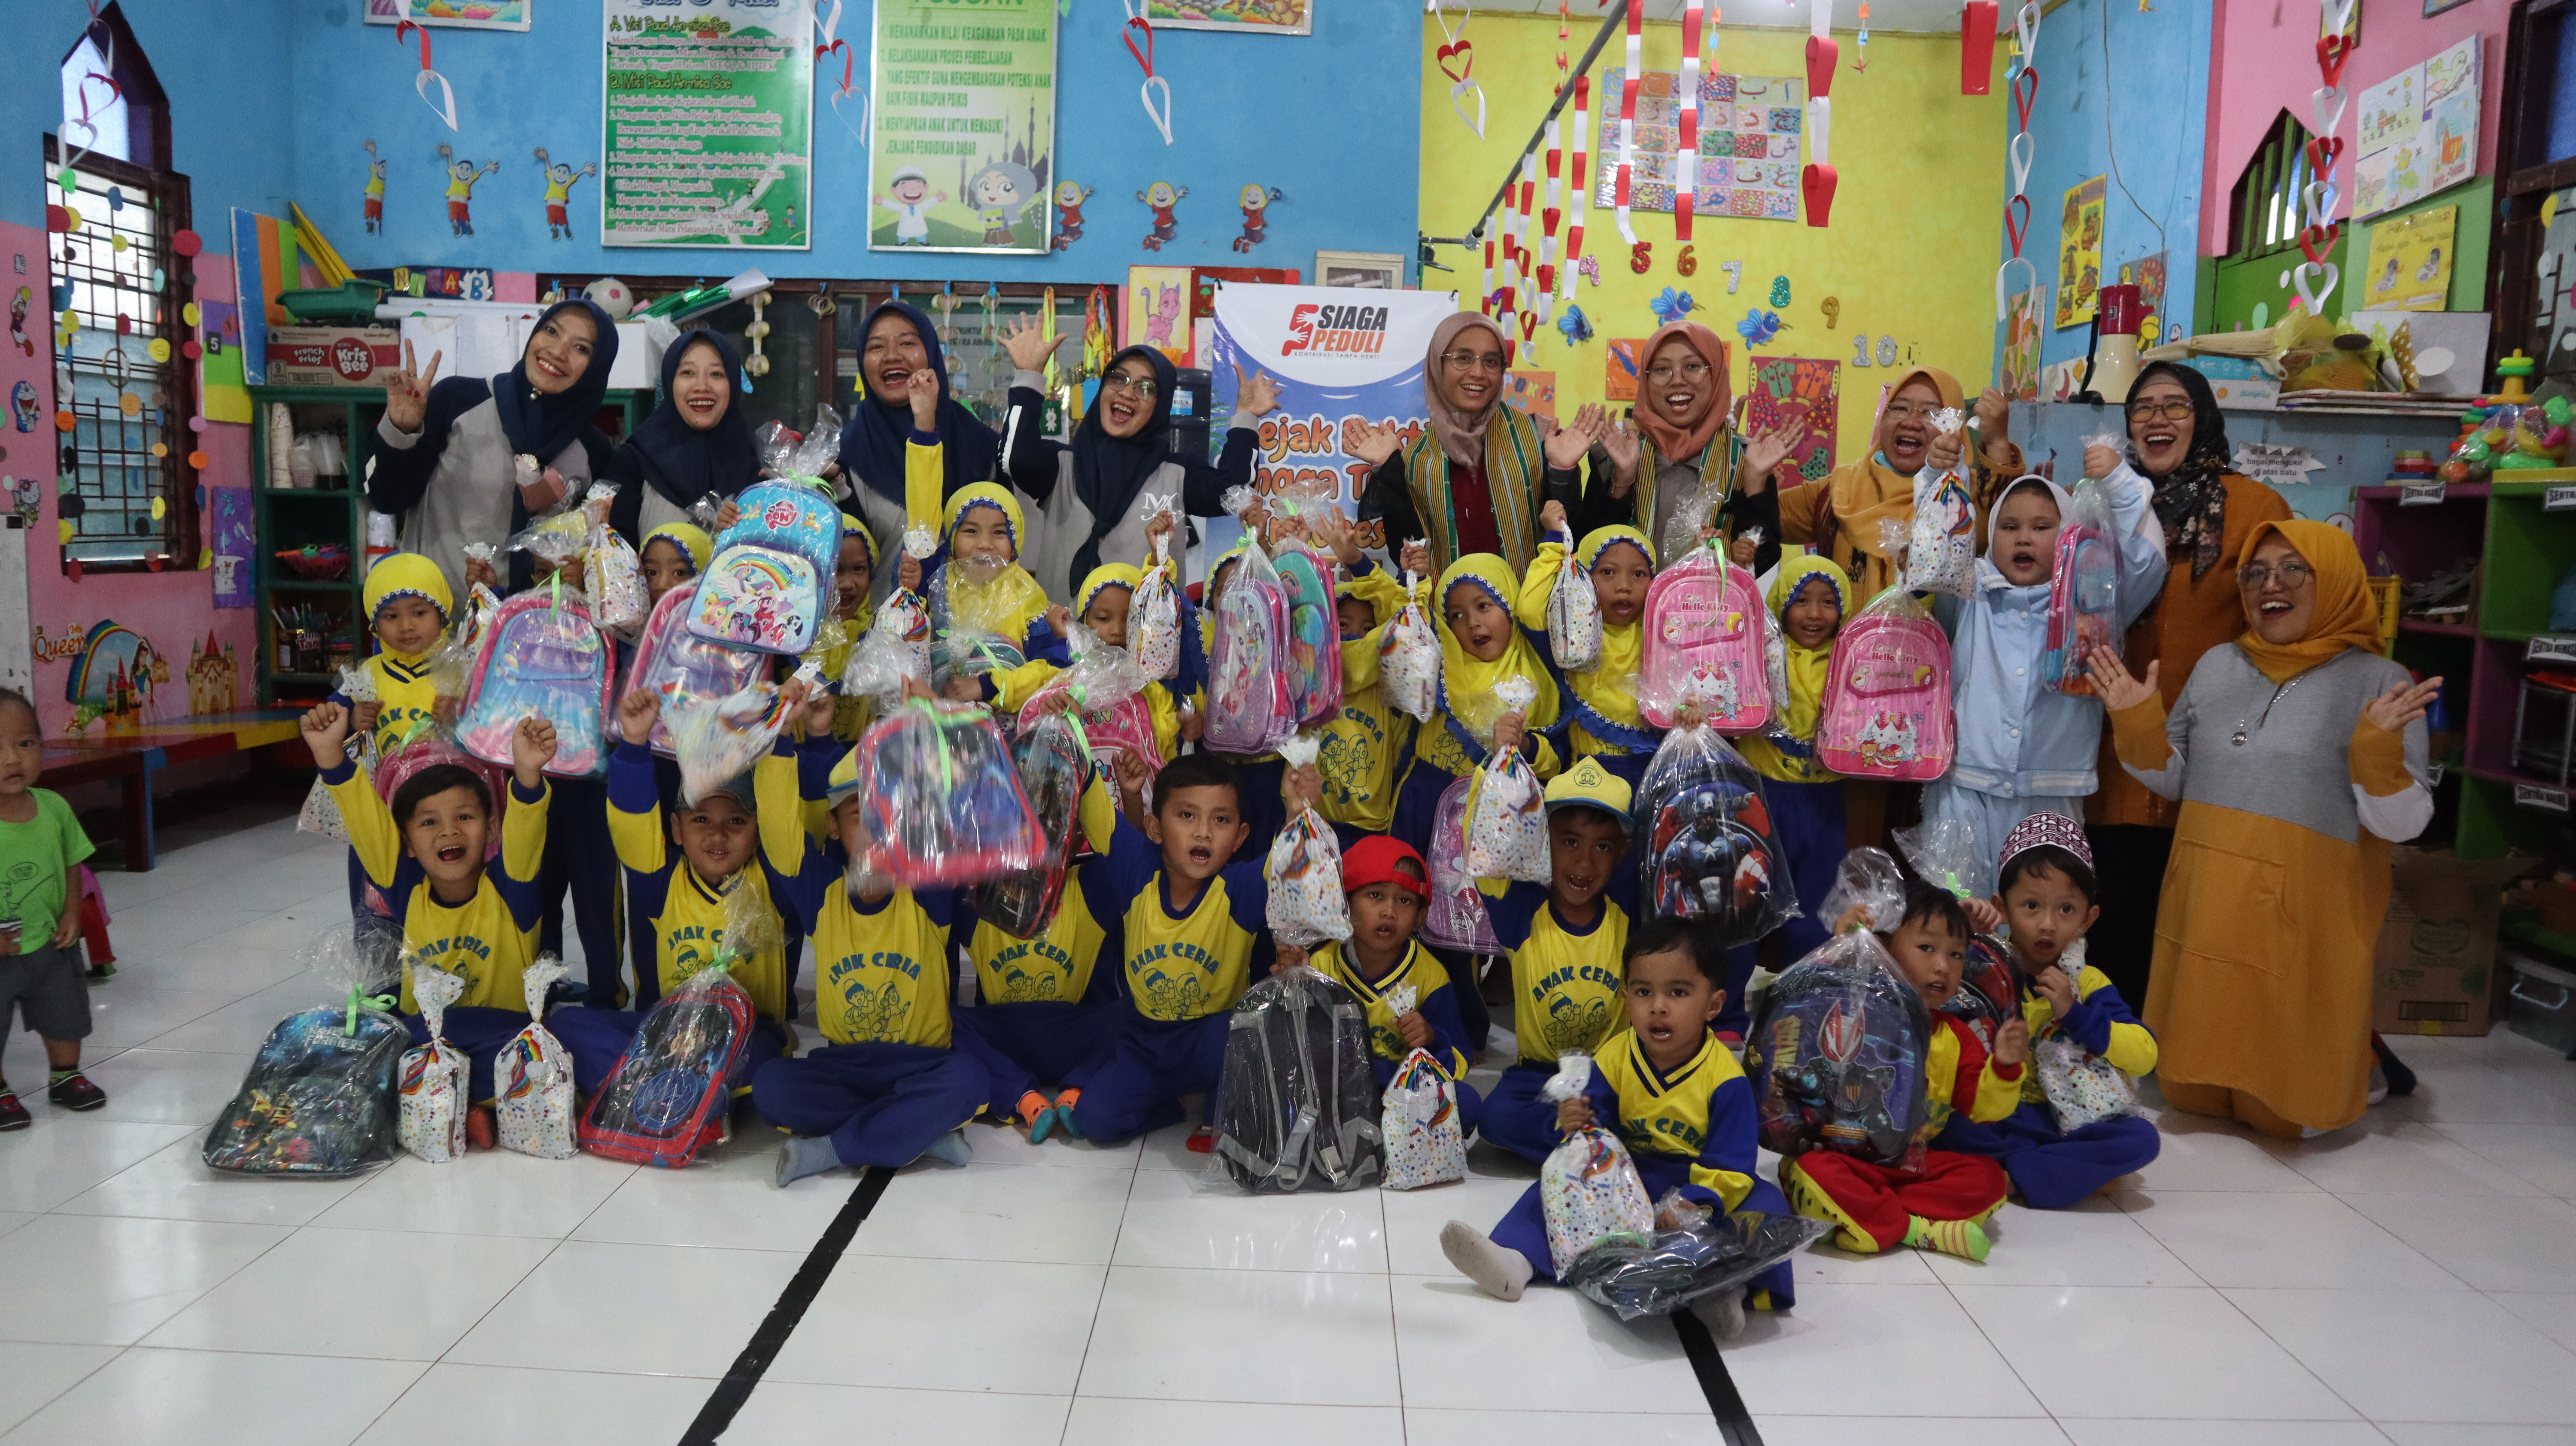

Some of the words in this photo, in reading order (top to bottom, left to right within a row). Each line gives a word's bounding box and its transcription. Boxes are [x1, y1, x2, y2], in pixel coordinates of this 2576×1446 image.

[624, 15, 642, 32] Visi
[645, 15, 670, 31] Paud
[1008, 27, 1025, 42] PADA
[1027, 28, 1047, 43] ANAK
[940, 50, 963, 64] PROSES
[622, 72, 644, 89] Misi
[646, 72, 671, 89] Paud
[887, 70, 903, 84] YANG
[1034, 73, 1051, 88] ANAK
[928, 118, 945, 132] ANAK
[947, 118, 968, 132] UNTUK
[886, 140, 914, 154] JENJANG
[956, 140, 977, 155] DASAR
[1579, 254, 1601, 286] 4
[1631, 242, 1652, 274] 5
[1677, 245, 1697, 276] 6
[1721, 260, 1742, 294] 7
[1769, 275, 1791, 308] 8
[1318, 304, 1388, 331] SIAGA
[1821, 296, 1840, 329] 9
[210, 337, 219, 351] 5
[294, 347, 325, 357] French
[1310, 329, 1385, 353] PEDULI
[1852, 334, 1897, 367] 10
[298, 354, 322, 365] Fries
[336, 346, 368, 362] Kris
[339, 360, 369, 375] Bee
[1258, 416, 1333, 463] ejak
[2247, 458, 2267, 466] bagai
[2269, 459, 2303, 467] mengukir
[1255, 467, 1338, 505] ngga
[1681, 602, 1705, 611] Hello
[33, 636, 87, 662] Queen
[1871, 651, 1895, 662] Hello
[1080, 710, 1114, 726] ITTY
[1344, 707, 1384, 744] CERIA
[669, 926, 706, 951] ANAK
[829, 952, 866, 986] ANAK
[989, 943, 1029, 974] ANAK
[1130, 943, 1168, 976] ANAK
[1171, 942, 1221, 976] CERIA
[1532, 966, 1575, 1003] ANAK
